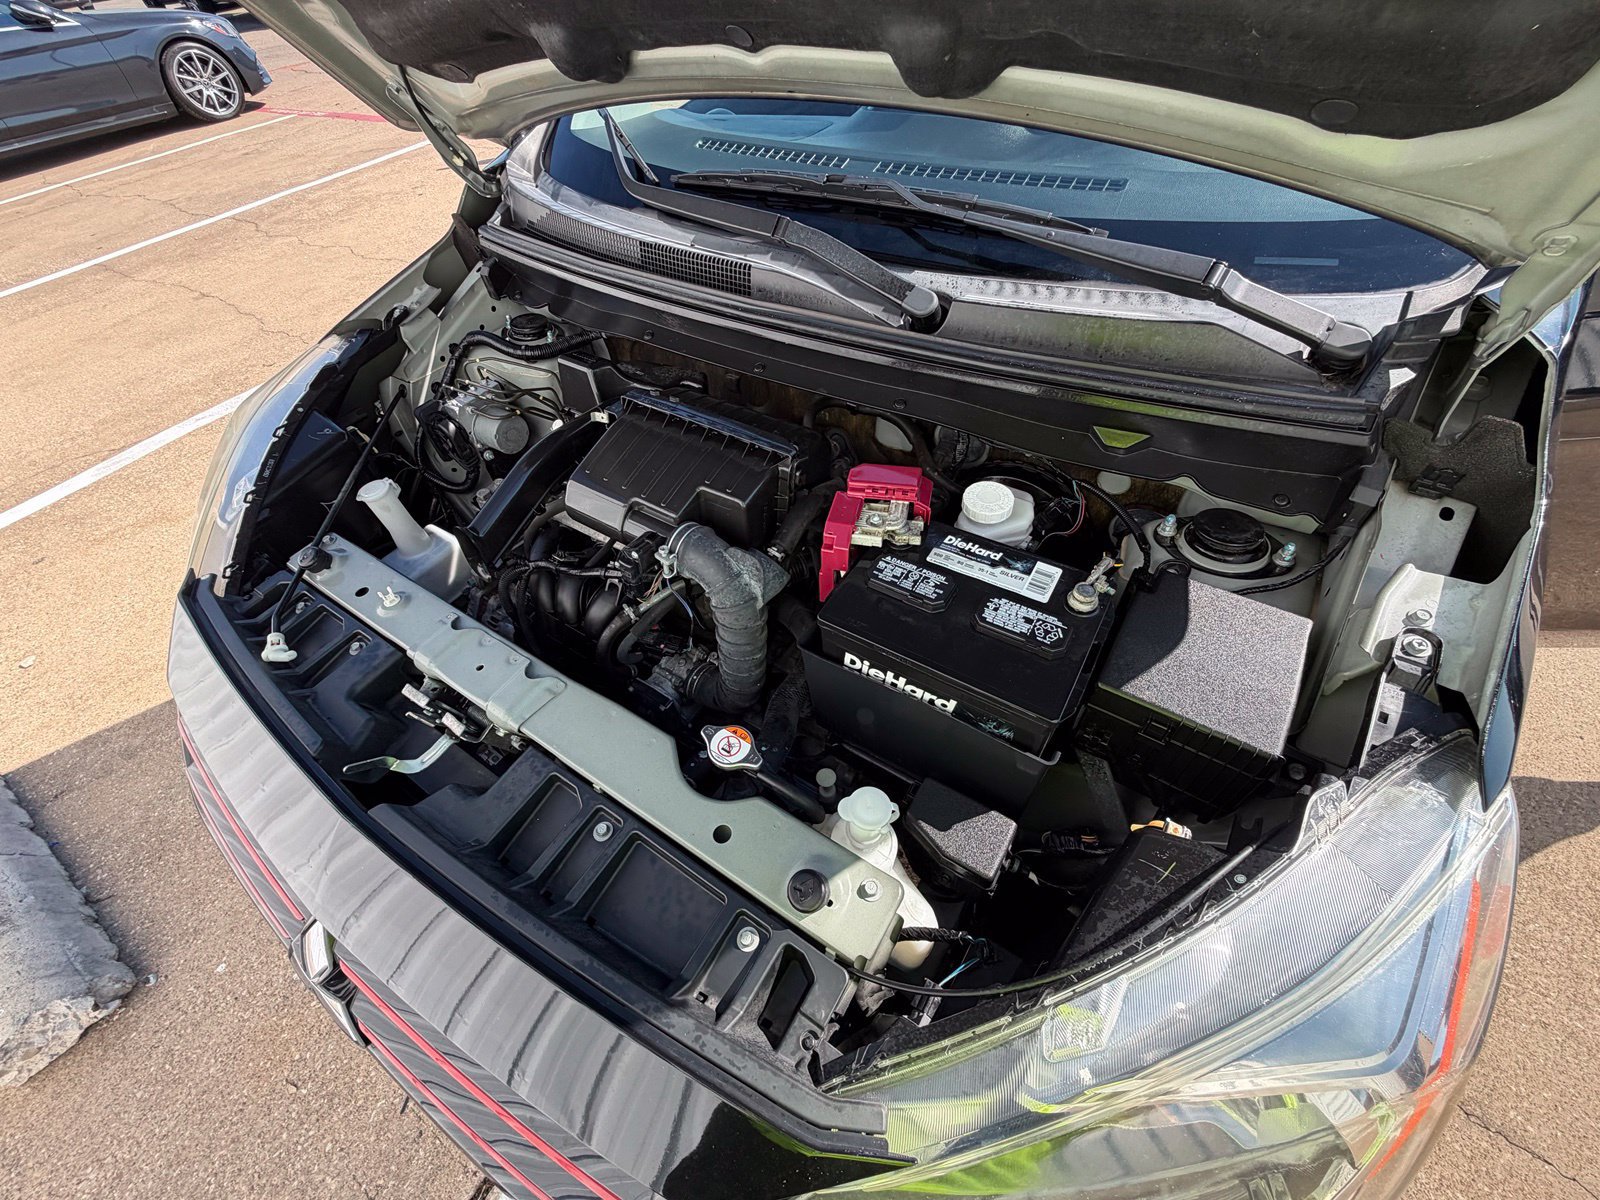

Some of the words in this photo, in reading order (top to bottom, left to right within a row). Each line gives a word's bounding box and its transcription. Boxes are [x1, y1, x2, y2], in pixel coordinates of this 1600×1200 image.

[943, 535, 1004, 561] DieHard
[891, 557, 917, 571] DANGER
[922, 568, 947, 581] POISON
[999, 570, 1025, 582] SILVER
[844, 651, 958, 714] DieHard
